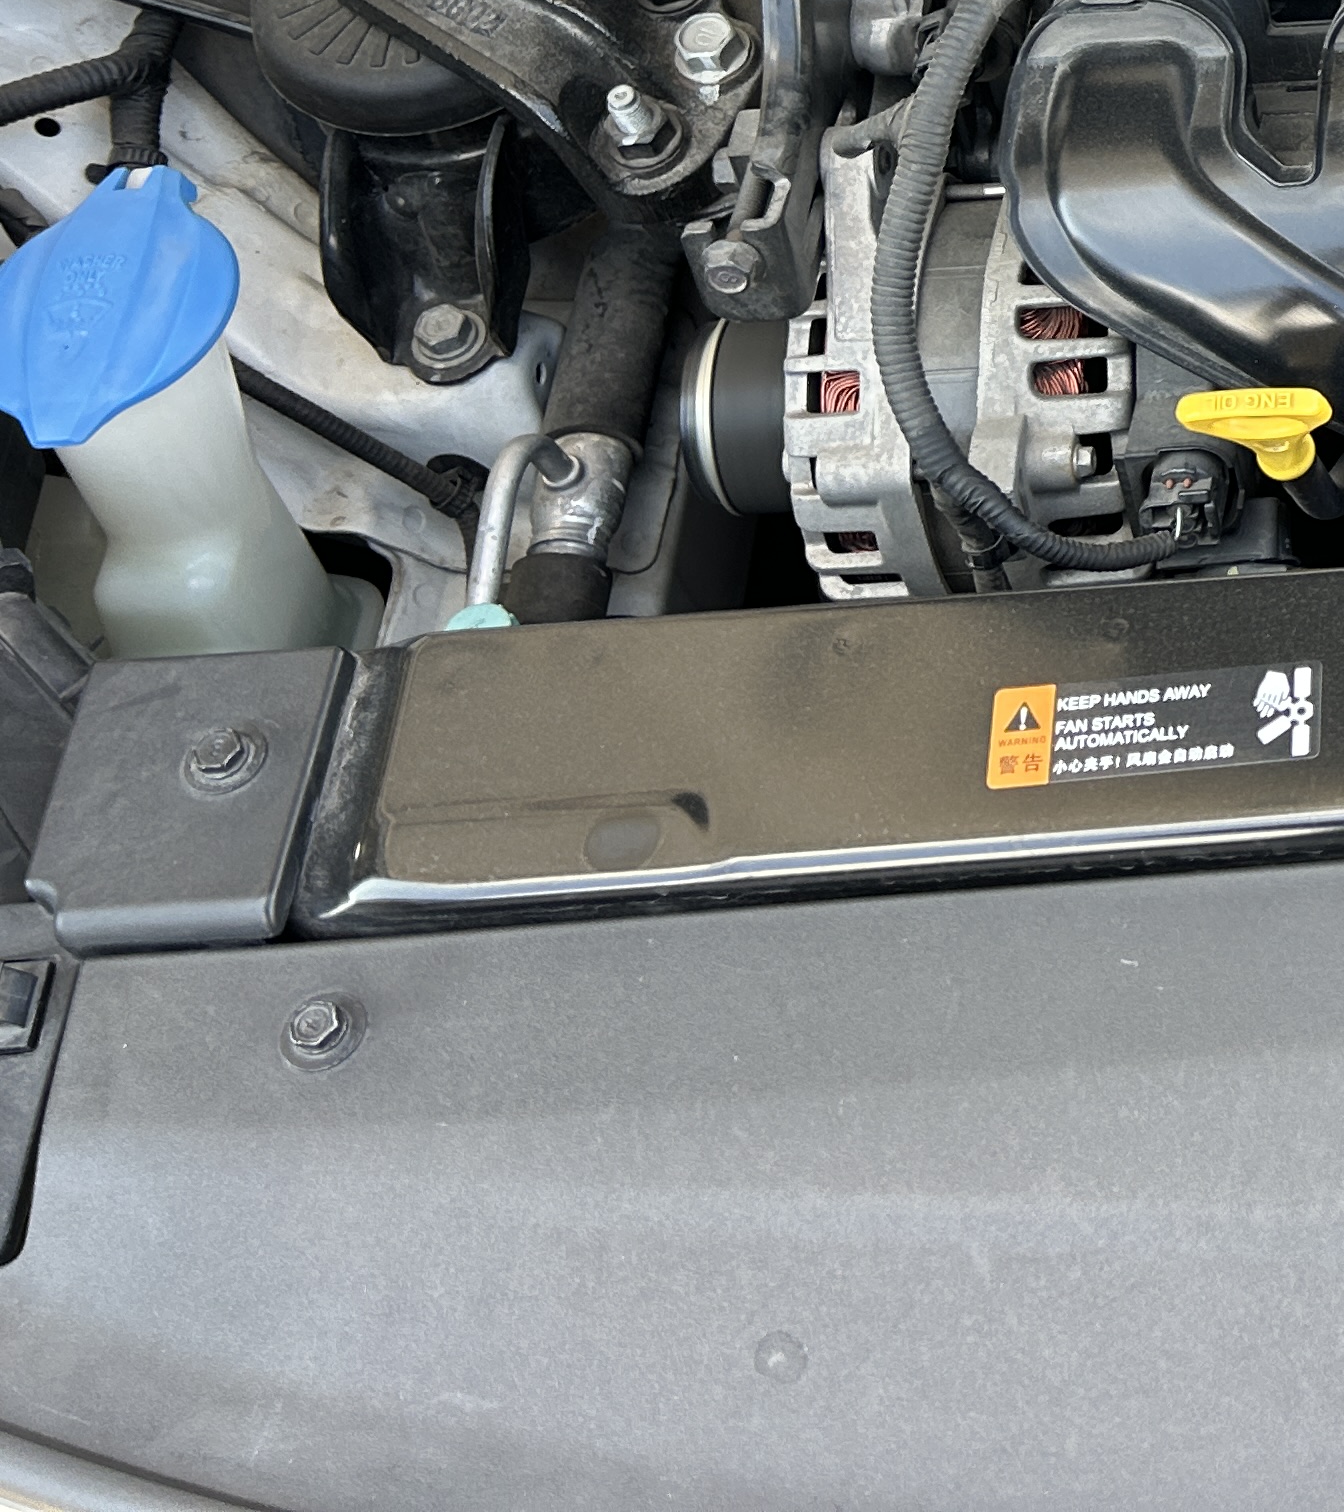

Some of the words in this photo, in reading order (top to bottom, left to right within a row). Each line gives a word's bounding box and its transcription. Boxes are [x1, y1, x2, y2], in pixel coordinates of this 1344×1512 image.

[1206, 394, 1237, 411] OIL
[1244, 392, 1294, 410] ENG
[1057, 694, 1102, 712] KEEP
[1103, 689, 1160, 707] HANDS
[1162, 683, 1212, 702] AWAY
[1055, 718, 1088, 735] FAN
[1091, 712, 1155, 732] STARTS
[997, 735, 1047, 748] WARNING
[1054, 725, 1189, 751] AUTOMATICALLY
[998, 753, 1044, 775] 警告
